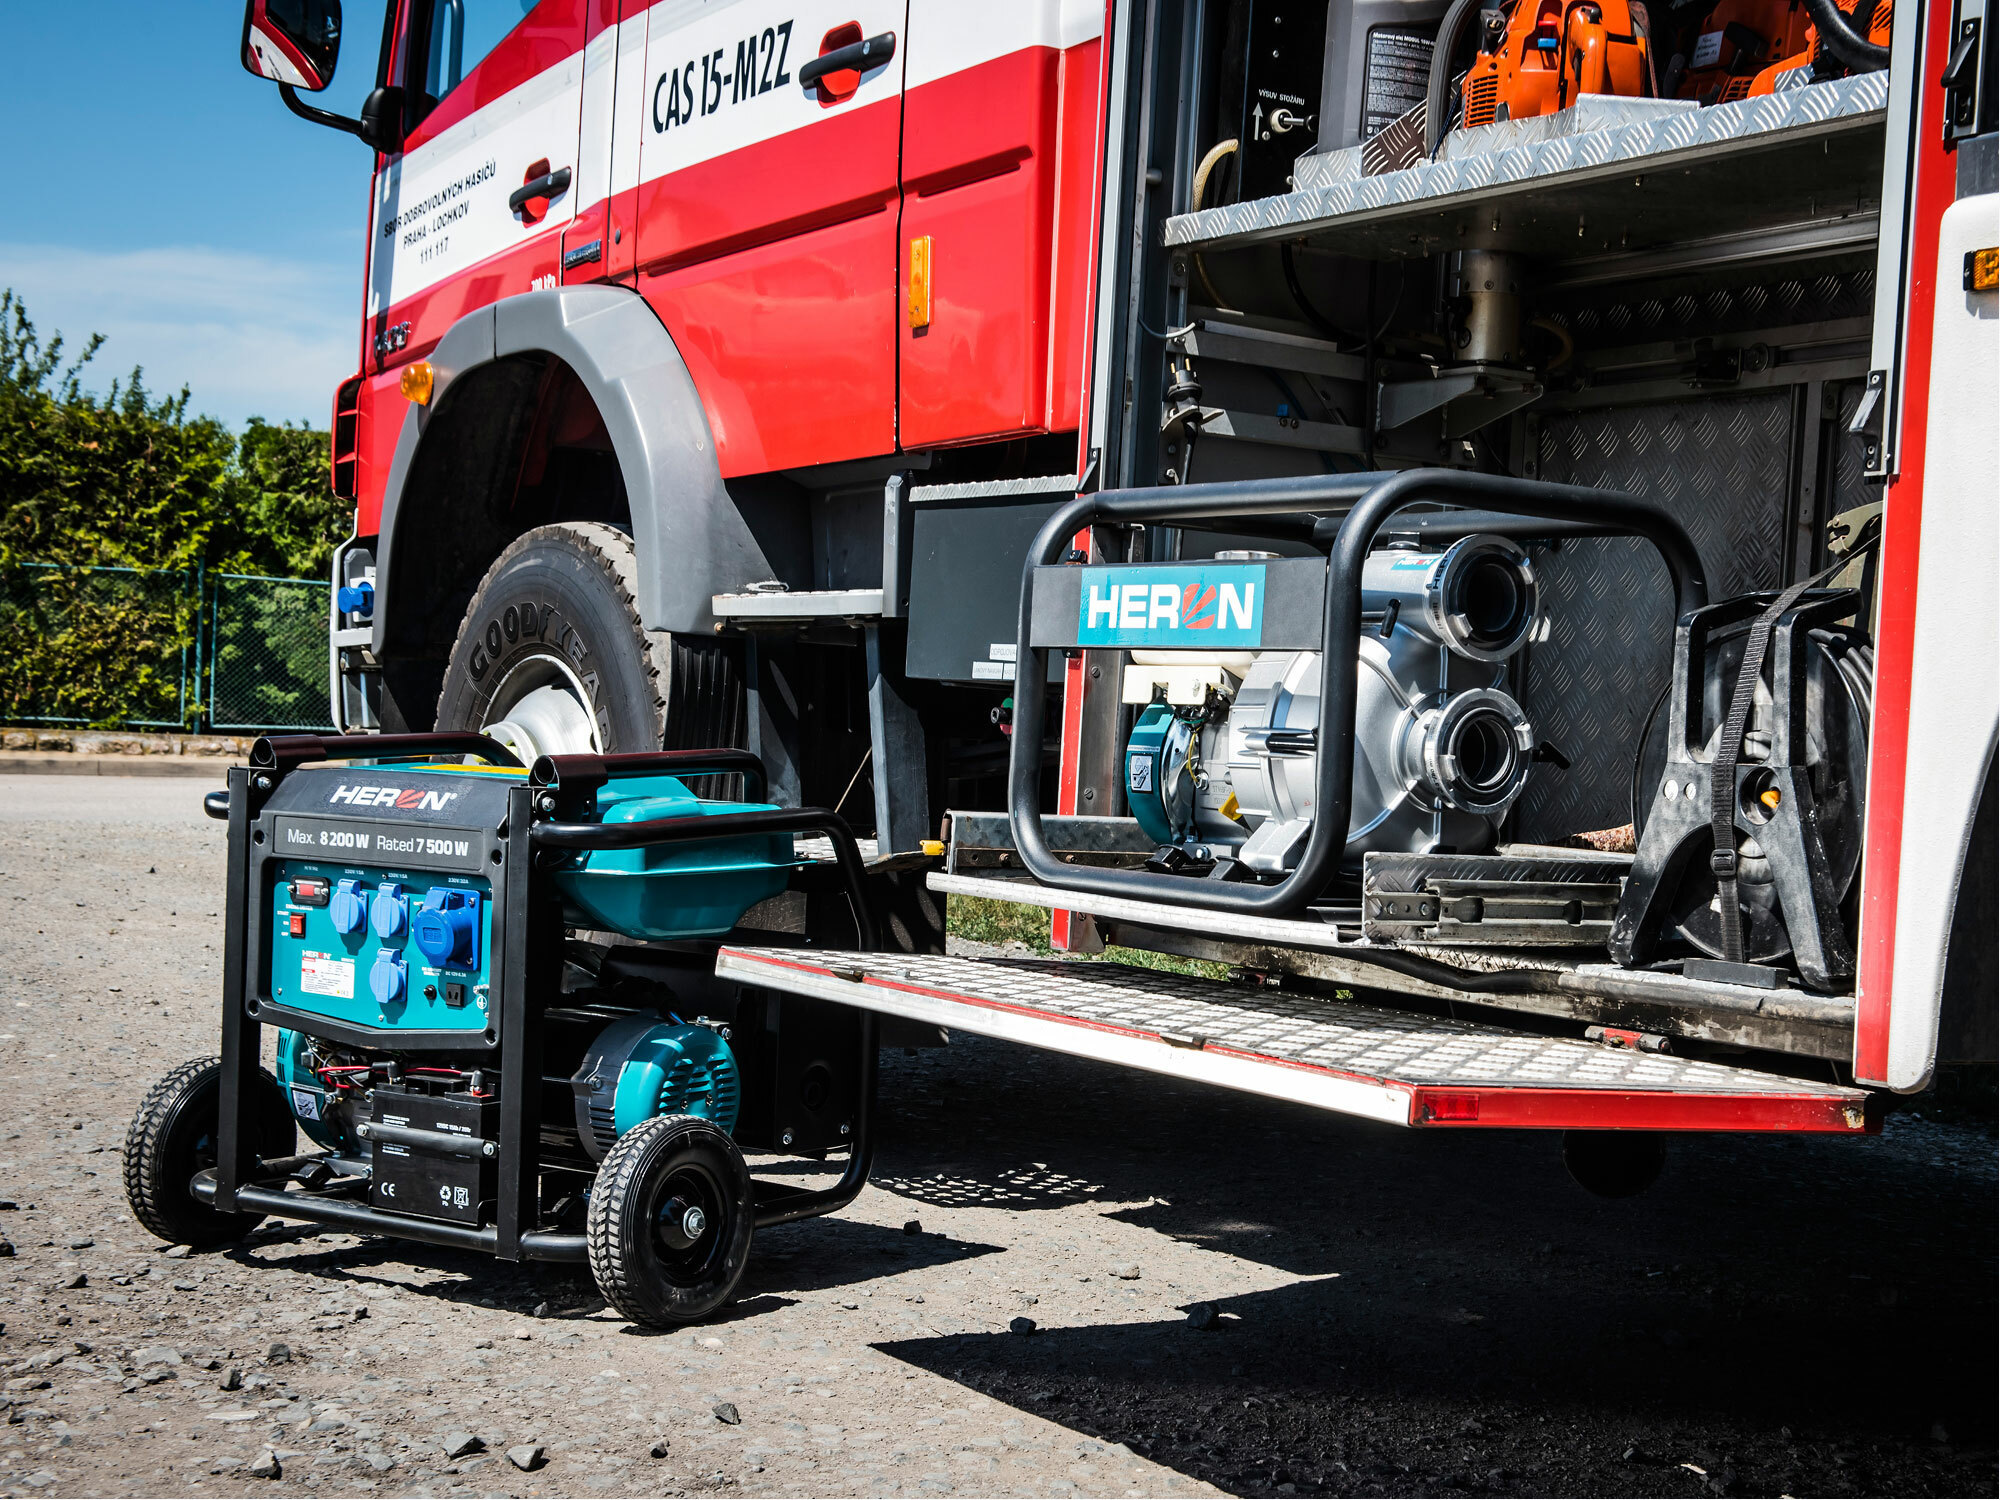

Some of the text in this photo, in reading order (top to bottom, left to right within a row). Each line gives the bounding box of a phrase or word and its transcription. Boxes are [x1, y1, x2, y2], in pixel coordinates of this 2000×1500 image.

[653, 18, 794, 134] CAS 15-M2Z
[1259, 88, 1305, 106] VÝSUV STOŽÁRU
[384, 158, 496, 238] SBOR DOBROVOLNÝCH HASIČŮ
[403, 225, 427, 249] PRAHA
[433, 200, 470, 232] LOCHKOV
[421, 237, 449, 264] 111 117
[1087, 583, 1255, 629] HERON
[287, 828, 316, 845] Max.
[376, 835, 414, 852] Rated
[381, 1182, 396, 1197] CE
